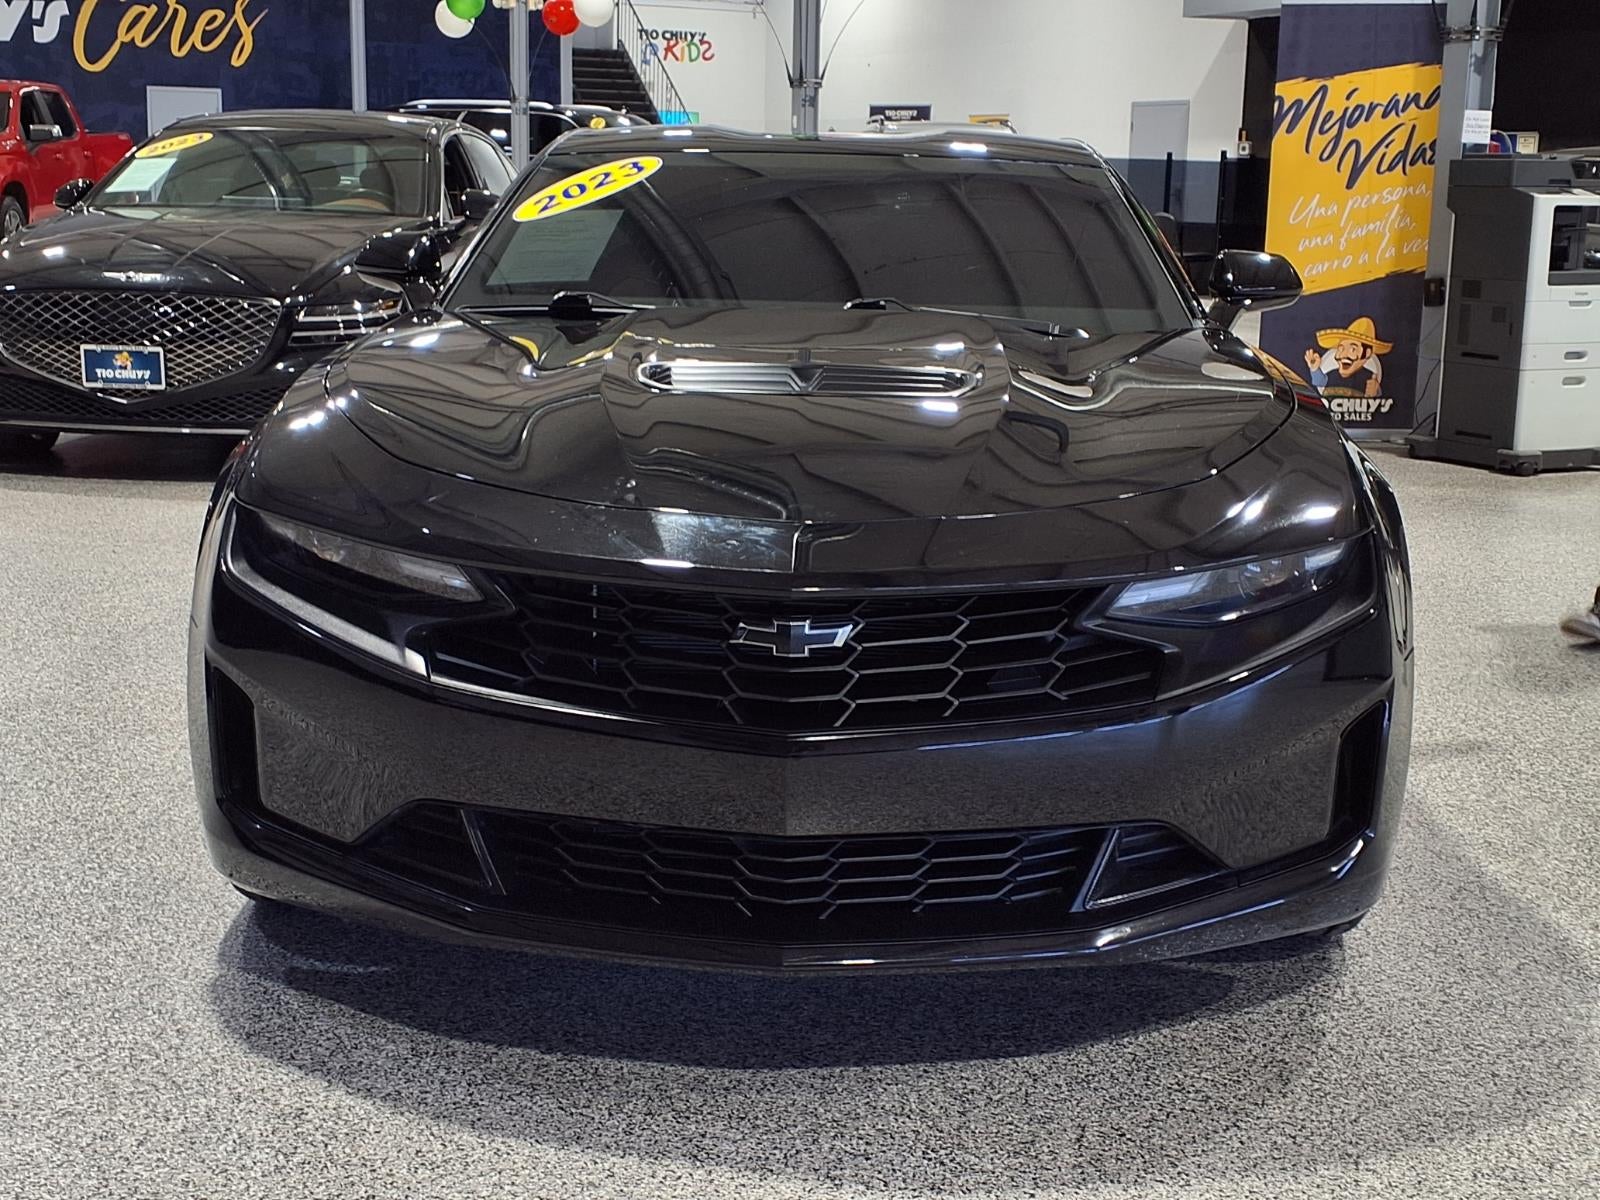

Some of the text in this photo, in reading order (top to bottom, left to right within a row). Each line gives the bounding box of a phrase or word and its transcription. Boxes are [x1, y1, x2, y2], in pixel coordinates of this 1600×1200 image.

[73, 0, 268, 72] Cares
[534, 161, 645, 214] 2023
[1289, 182, 1432, 228] Una persona,
[1298, 203, 1416, 252] una familia,
[1304, 254, 1353, 277] carro
[1358, 252, 1369, 265] a
[1377, 233, 1396, 265] la
[96, 368, 113, 378] TIO
[1330, 398, 1393, 413] CHUY'S
[1344, 412, 1372, 421] SALES
